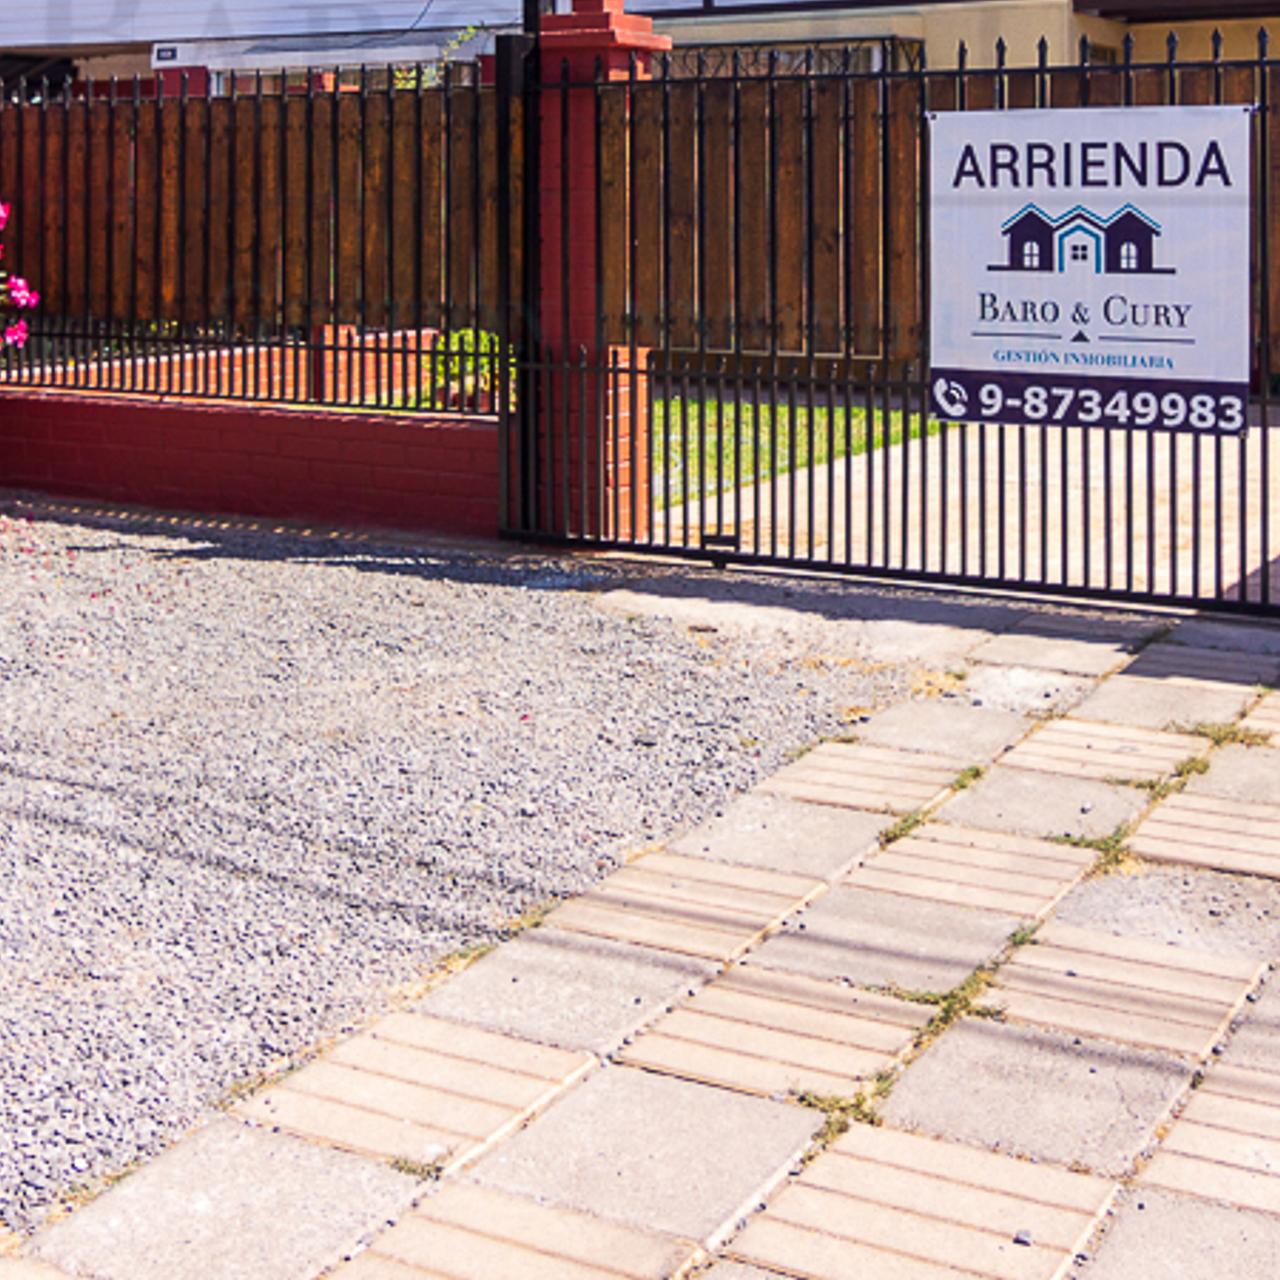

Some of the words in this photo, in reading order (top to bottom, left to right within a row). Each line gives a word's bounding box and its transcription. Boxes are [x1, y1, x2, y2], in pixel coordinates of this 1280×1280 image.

[952, 140, 1232, 188] ARRIENDA
[978, 292, 1060, 322] BARO
[1071, 302, 1090, 325] &
[1103, 295, 1193, 328] CURY
[993, 349, 1060, 364] GESTIÓN
[1064, 351, 1175, 370] INMOBILIARIA
[978, 382, 1245, 431] 9-87349983
